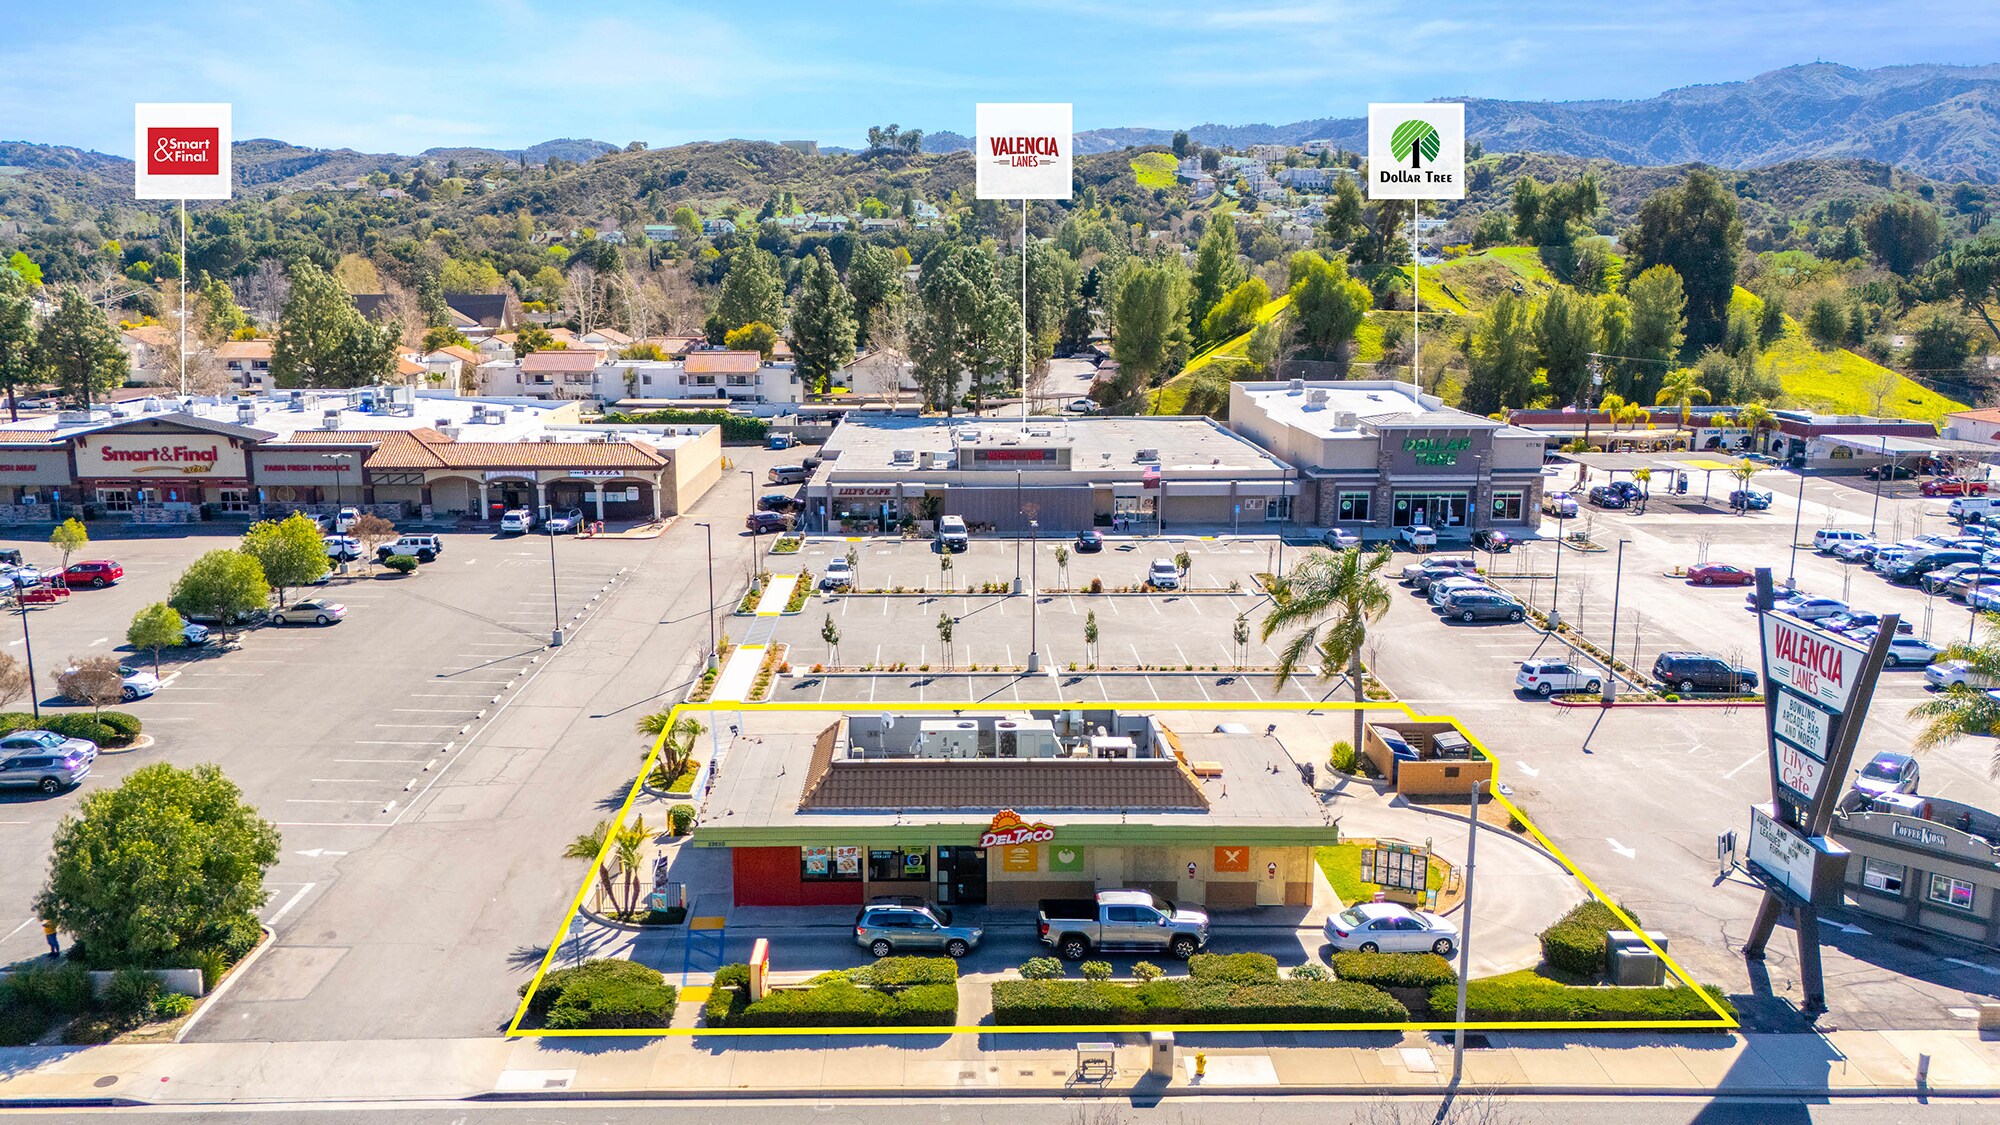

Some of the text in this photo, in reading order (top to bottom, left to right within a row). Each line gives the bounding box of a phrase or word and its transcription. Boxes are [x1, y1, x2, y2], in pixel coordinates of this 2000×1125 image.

[102, 446, 218, 462] Smart&Final
[1403, 437, 1473, 451] DOLLAR
[1416, 453, 1458, 465] TREE
[839, 488, 890, 496] LILY'S CAFE
[1775, 623, 1843, 689] VALENCIA
[1791, 664, 1819, 696] LANES
[1782, 710, 1806, 734] ARCADE,
[1789, 699, 1817, 723] BOWLING,
[1784, 724, 1816, 750] AND MORE!
[1783, 745, 1814, 777] Lily's
[1783, 767, 1810, 796] Cafe
[1757, 814, 1811, 858] ADULT AND JUNIOR
[1760, 826, 1800, 860] LEAGUES NOW
